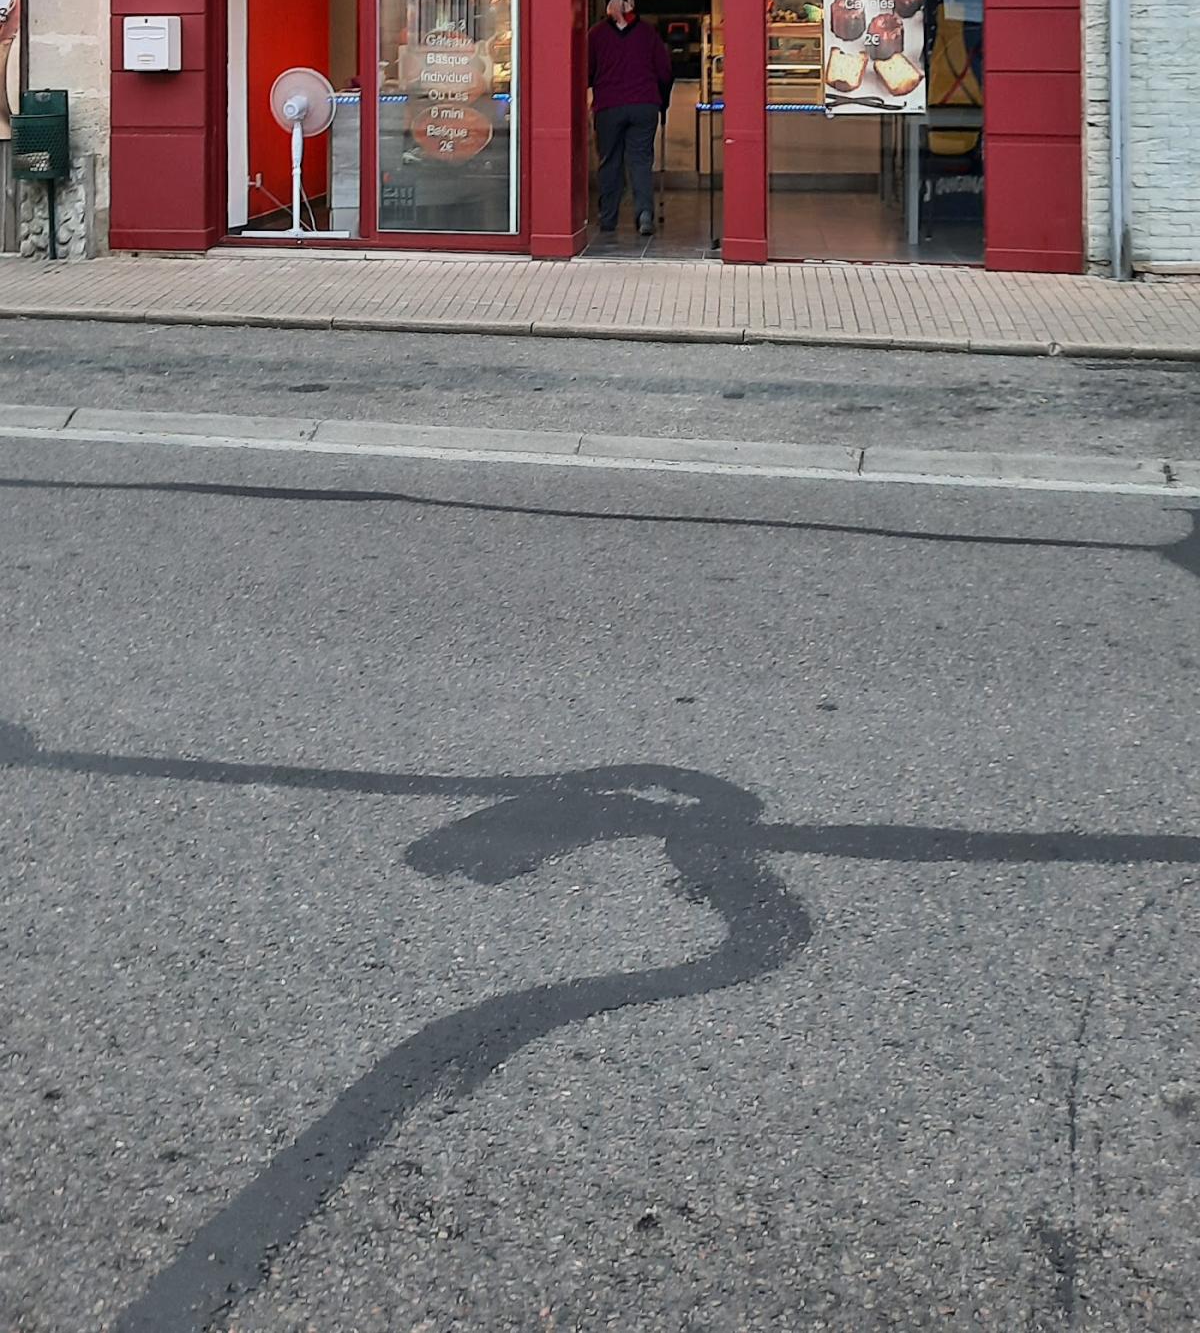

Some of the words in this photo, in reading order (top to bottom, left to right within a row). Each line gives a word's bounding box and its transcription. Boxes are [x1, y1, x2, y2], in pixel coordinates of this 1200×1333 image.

[427, 53, 469, 67] Basque
[421, 71, 472, 83] Individuel
[429, 89, 445, 100] Ou
[448, 90, 468, 101] Les
[441, 108, 464, 119] mini
[427, 125, 468, 139] Basque
